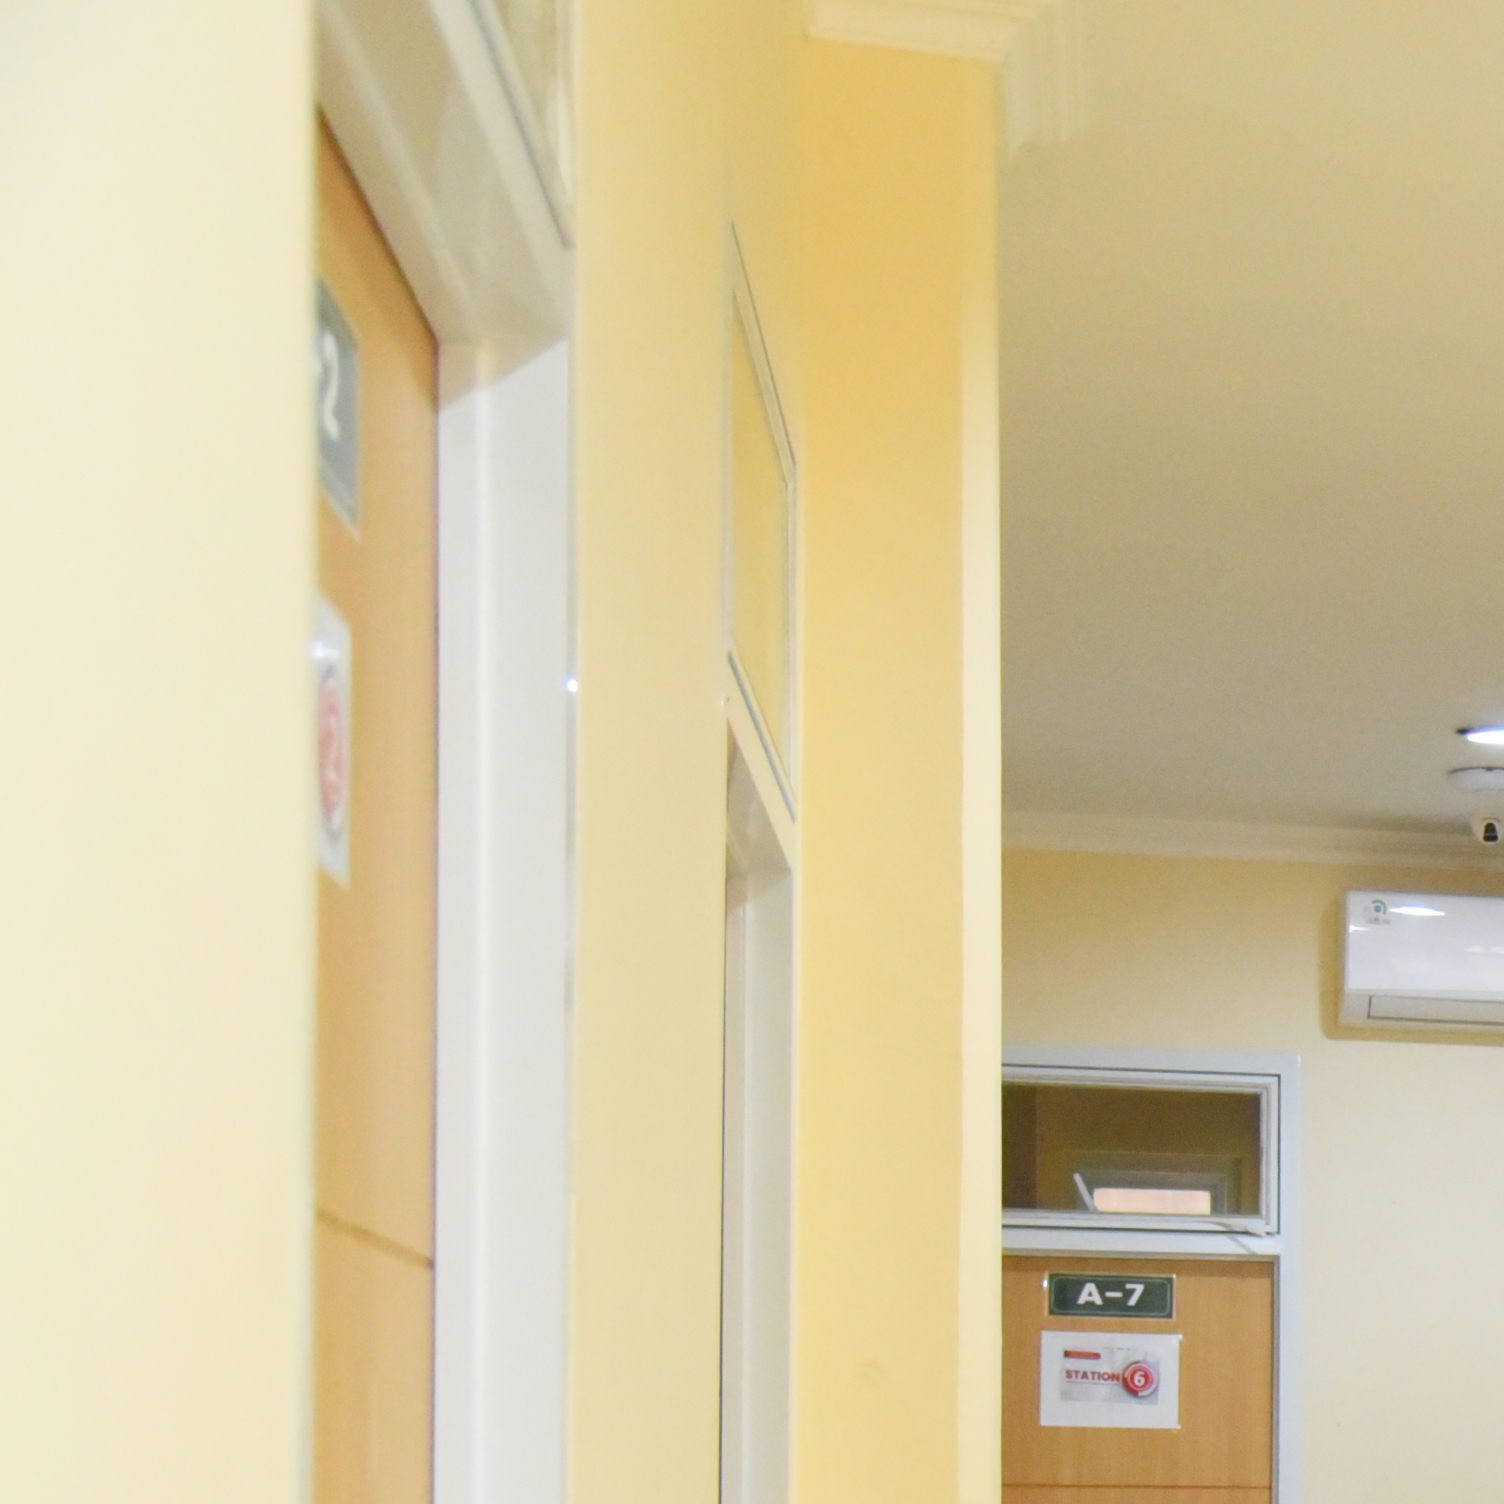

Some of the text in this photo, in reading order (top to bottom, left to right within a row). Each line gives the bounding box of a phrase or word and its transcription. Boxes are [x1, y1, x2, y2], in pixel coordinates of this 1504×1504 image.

[1076, 1282, 1146, 1307] A-7
[1065, 1370, 1146, 1387] STATION 6
